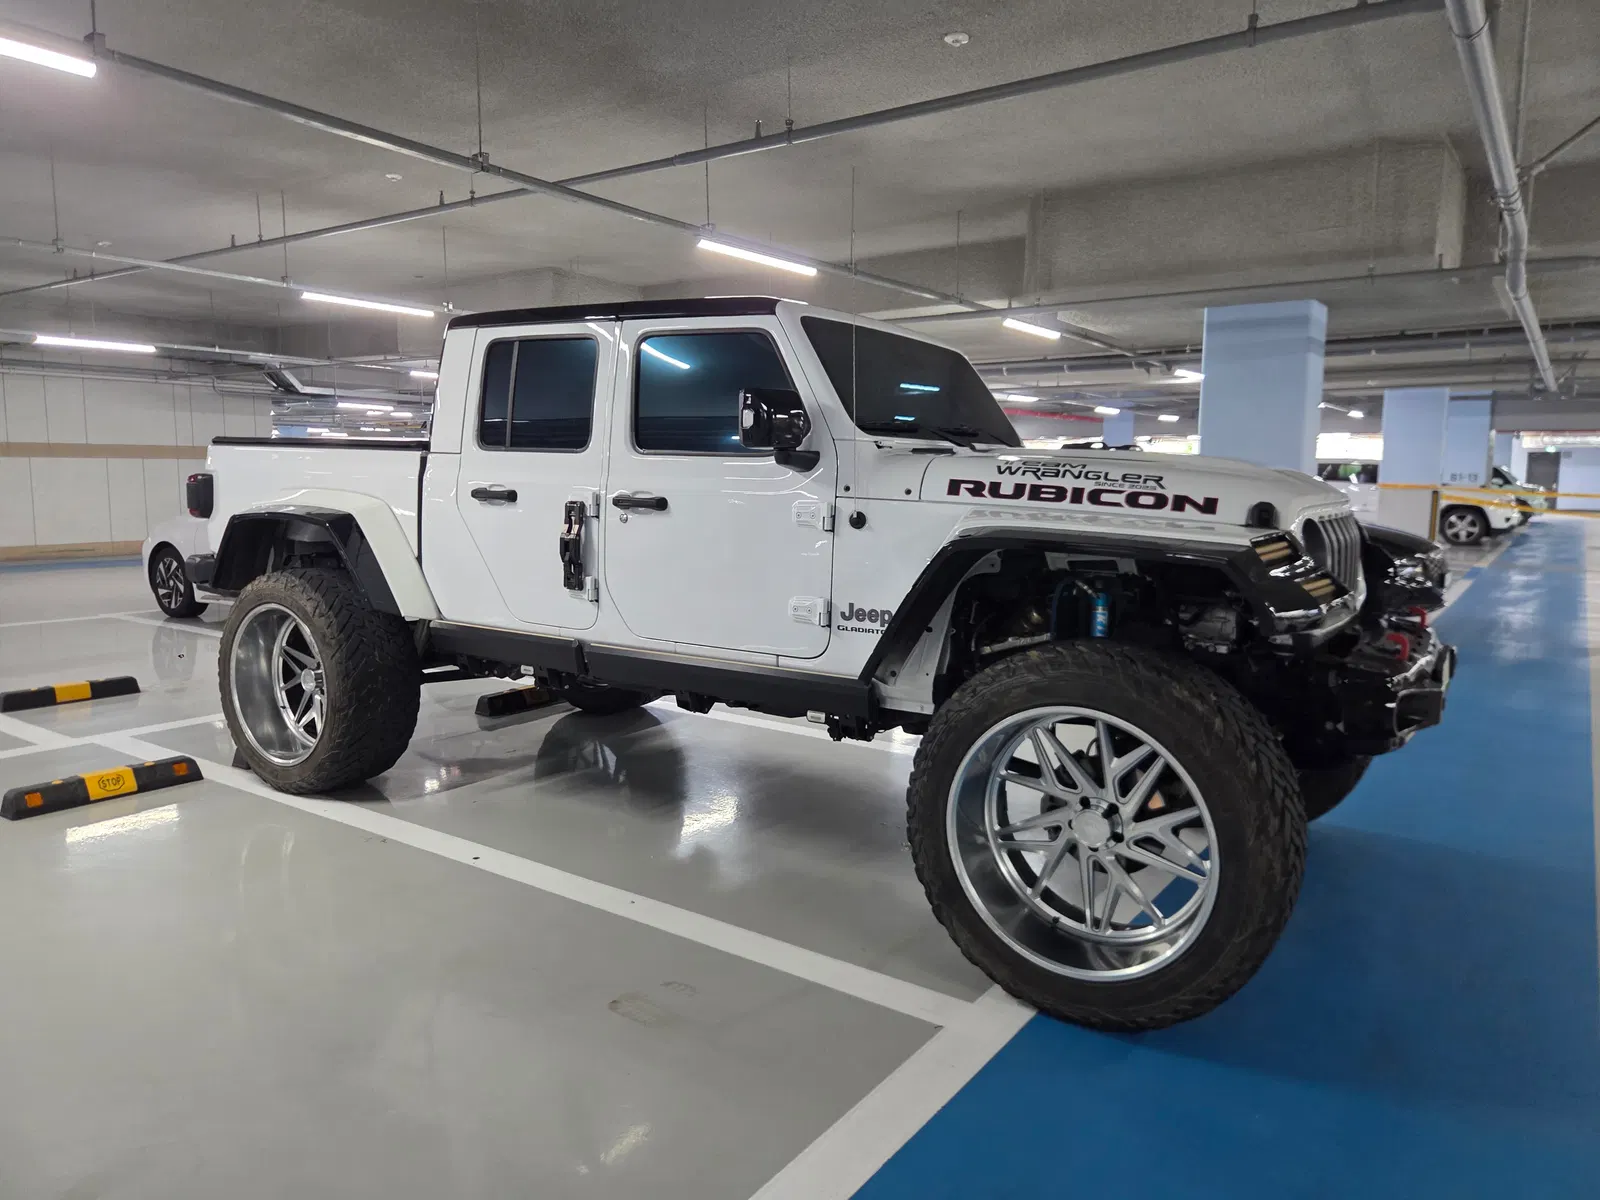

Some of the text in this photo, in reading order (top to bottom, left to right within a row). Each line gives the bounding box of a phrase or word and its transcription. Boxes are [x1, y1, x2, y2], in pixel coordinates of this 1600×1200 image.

[947, 478, 1219, 515] RUBICON
[840, 602, 893, 627] Jeep
[101, 776, 121, 788] STOP
